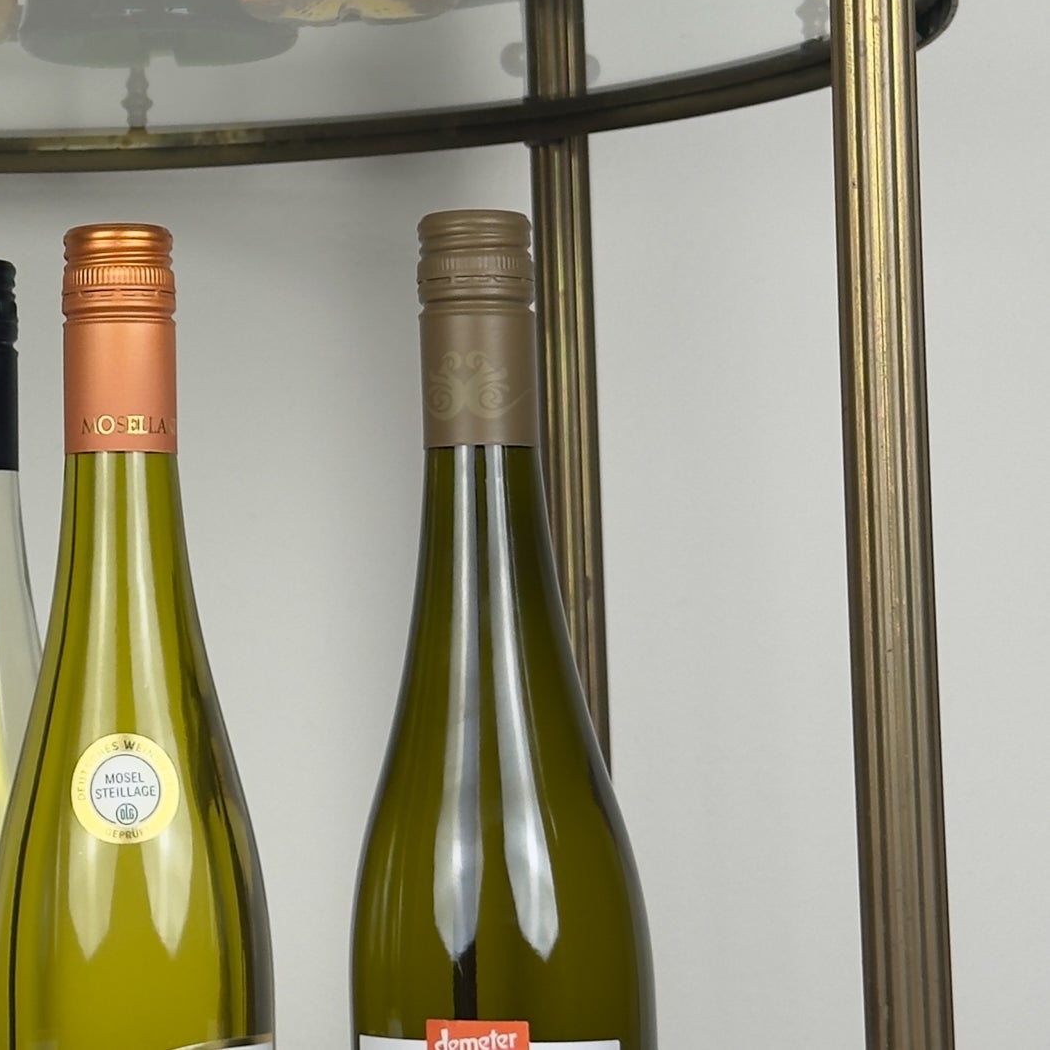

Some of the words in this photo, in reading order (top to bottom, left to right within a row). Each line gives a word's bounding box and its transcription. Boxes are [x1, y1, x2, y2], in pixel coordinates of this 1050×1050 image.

[81, 414, 175, 435] MOSELLA
[104, 772, 145, 784] MOSEL
[95, 785, 157, 800] STEILLAGE
[434, 1028, 518, 1050] demeter
